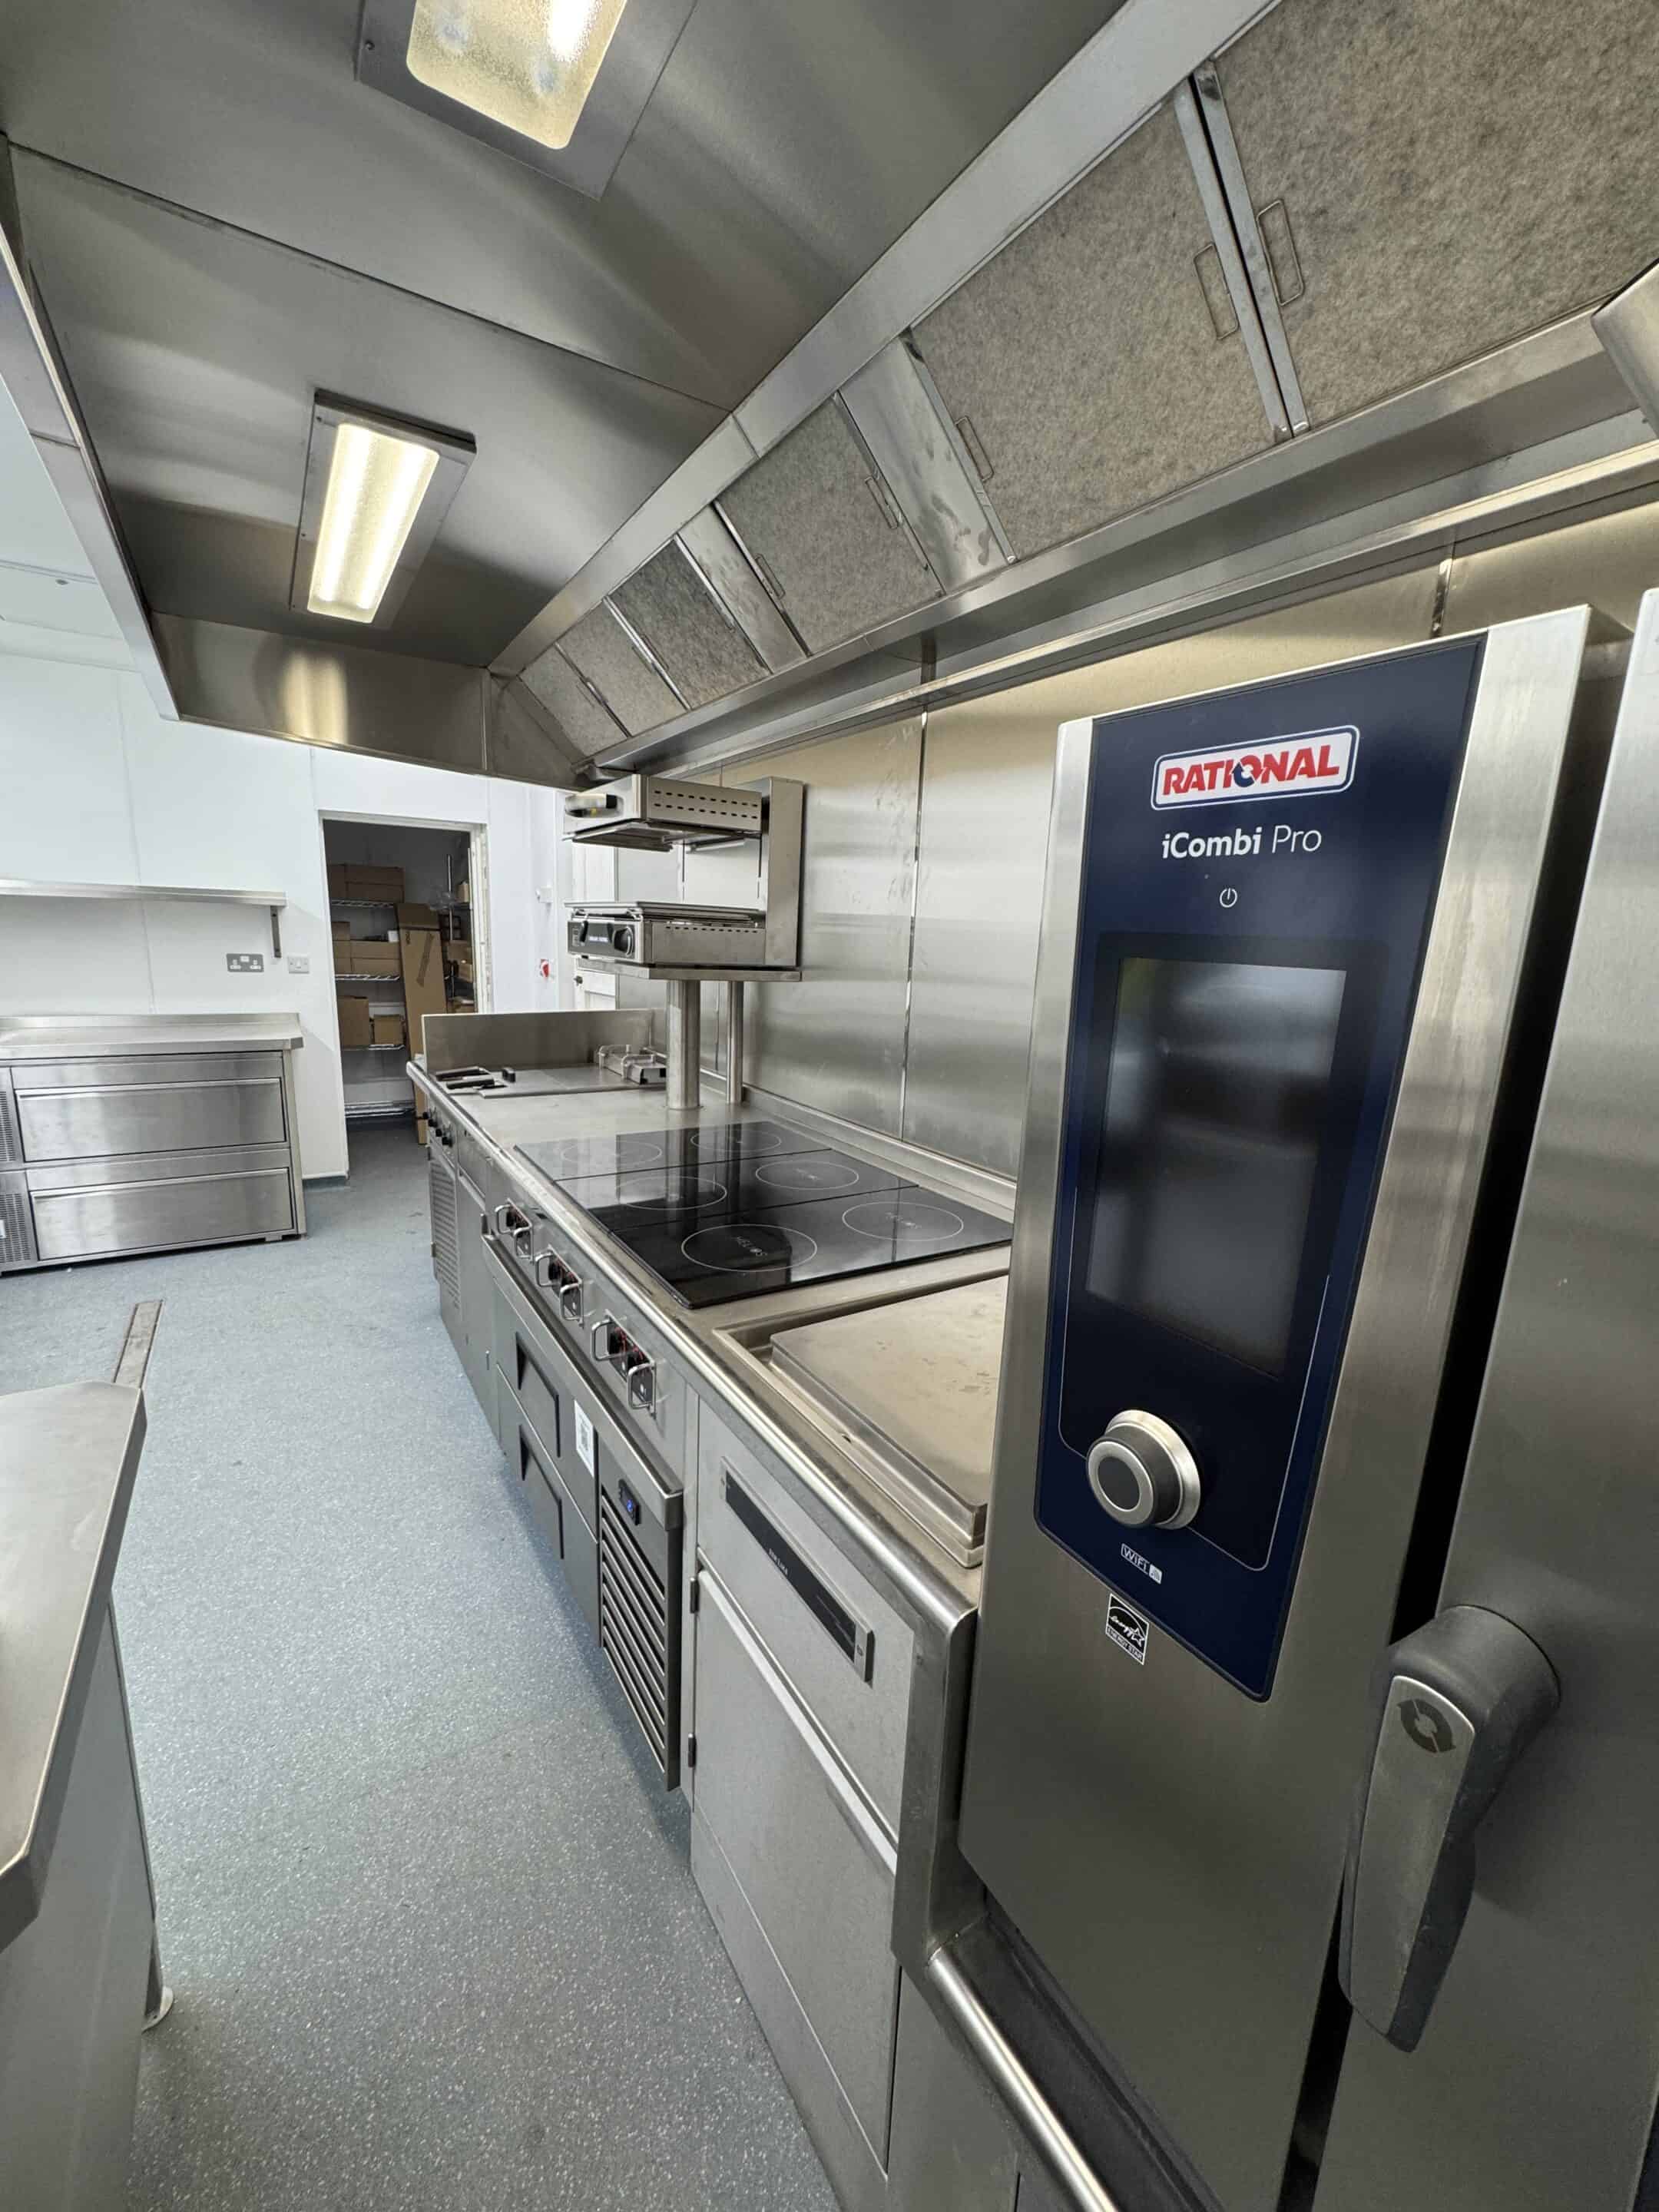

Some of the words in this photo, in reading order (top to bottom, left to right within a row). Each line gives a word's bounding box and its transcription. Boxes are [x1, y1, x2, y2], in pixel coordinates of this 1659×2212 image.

[1162, 745, 1340, 795] RATIONAL
[1162, 827, 1262, 859] iCombi
[1272, 824, 1322, 853] Pro
[1128, 1644, 1143, 1660] STAR
